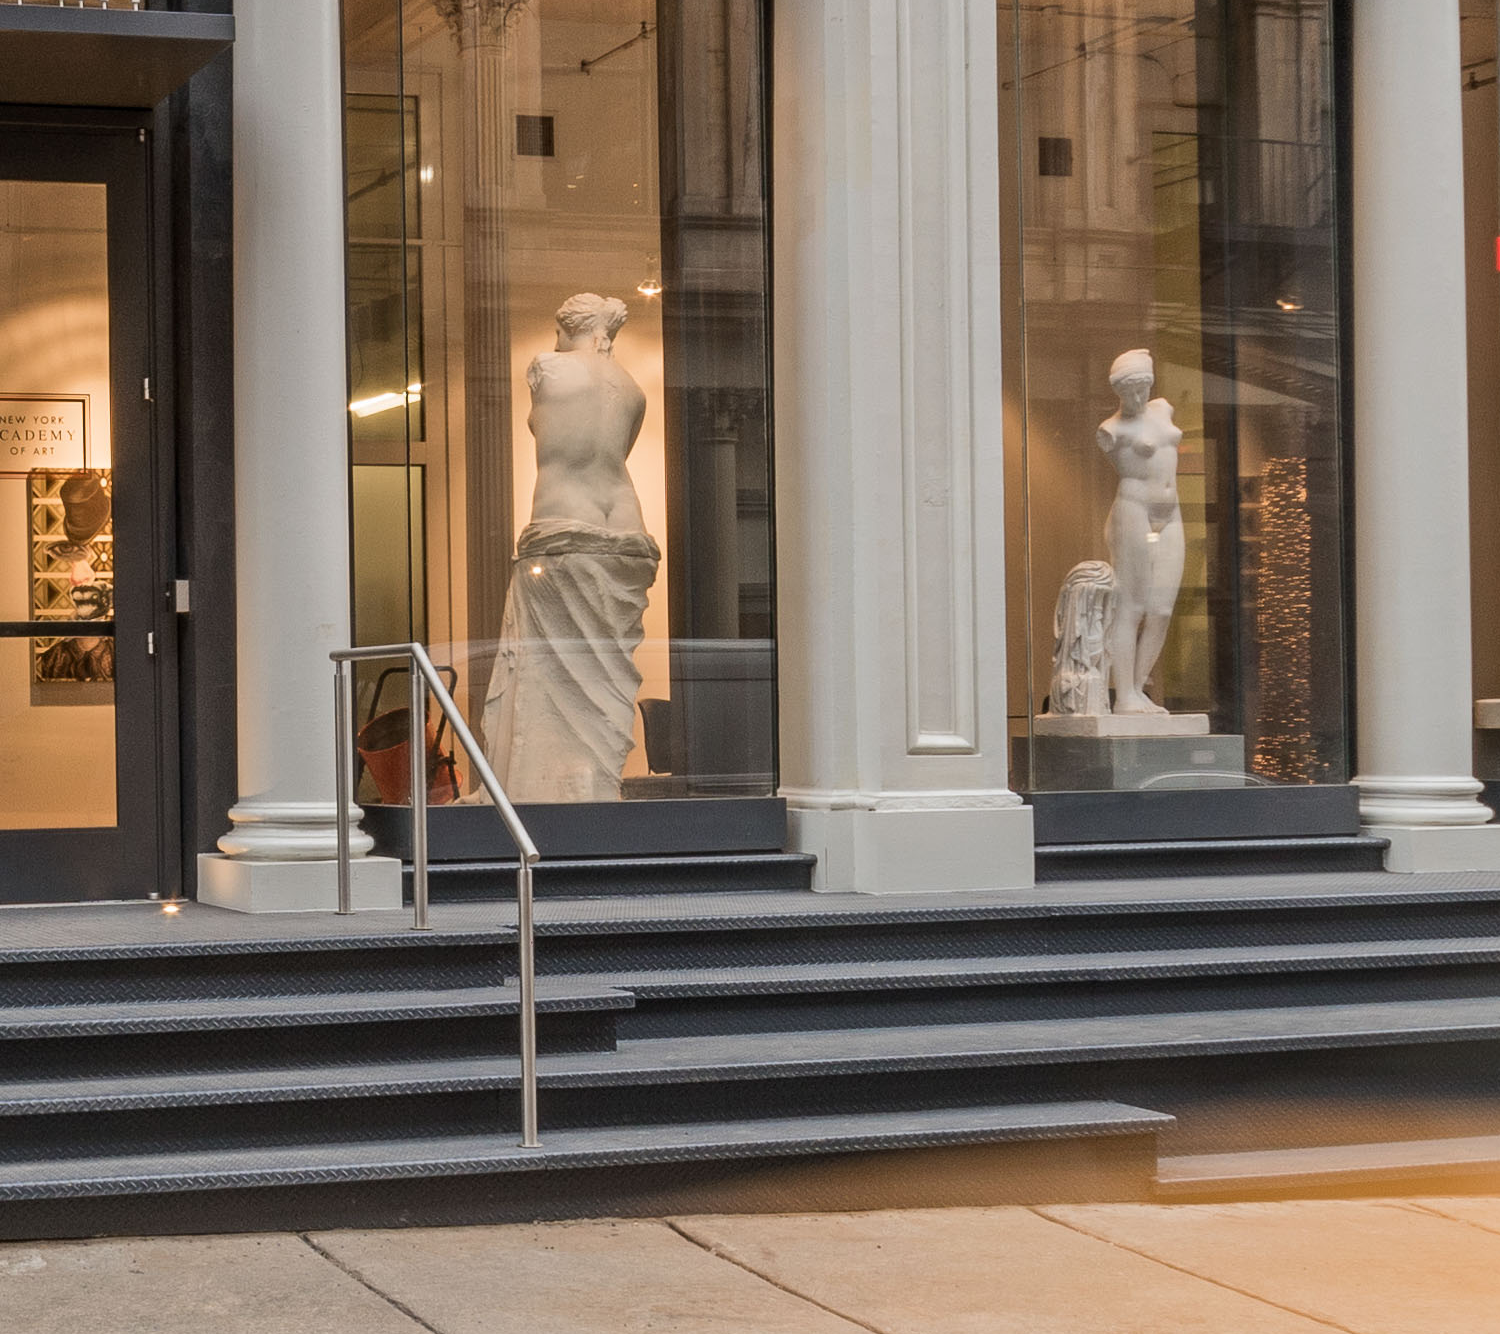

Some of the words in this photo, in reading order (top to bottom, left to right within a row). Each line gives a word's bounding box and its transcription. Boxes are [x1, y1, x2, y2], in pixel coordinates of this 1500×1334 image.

[33, 416, 65, 425] YORK
[10, 446, 26, 456] OF
[34, 446, 56, 456] ART
